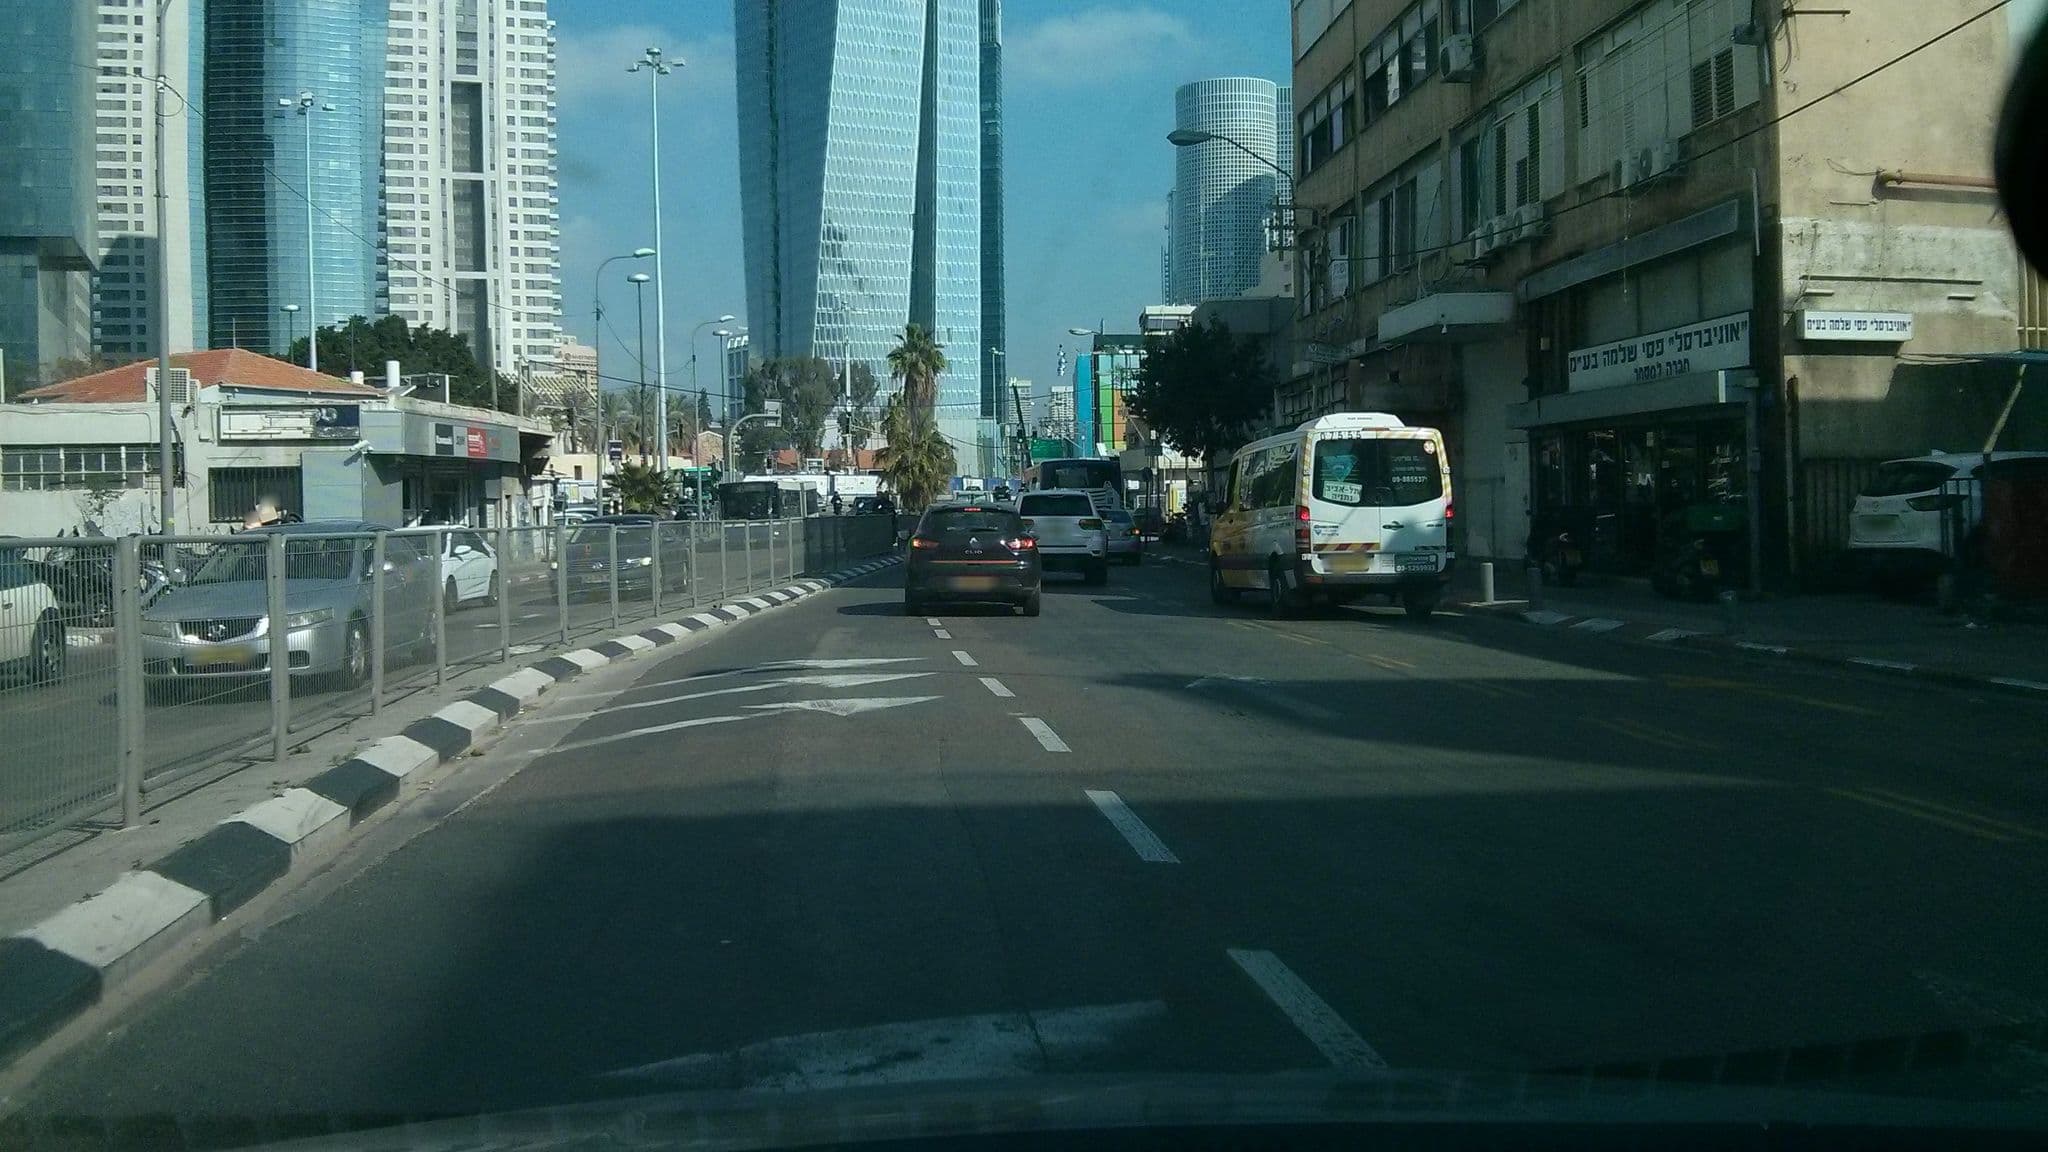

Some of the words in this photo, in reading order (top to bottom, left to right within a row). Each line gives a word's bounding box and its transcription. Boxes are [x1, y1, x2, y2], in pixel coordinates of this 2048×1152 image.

[1829, 317, 1851, 331] שלמה
[1602, 343, 1638, 367] שלמה
[1642, 338, 1665, 359] פסי
